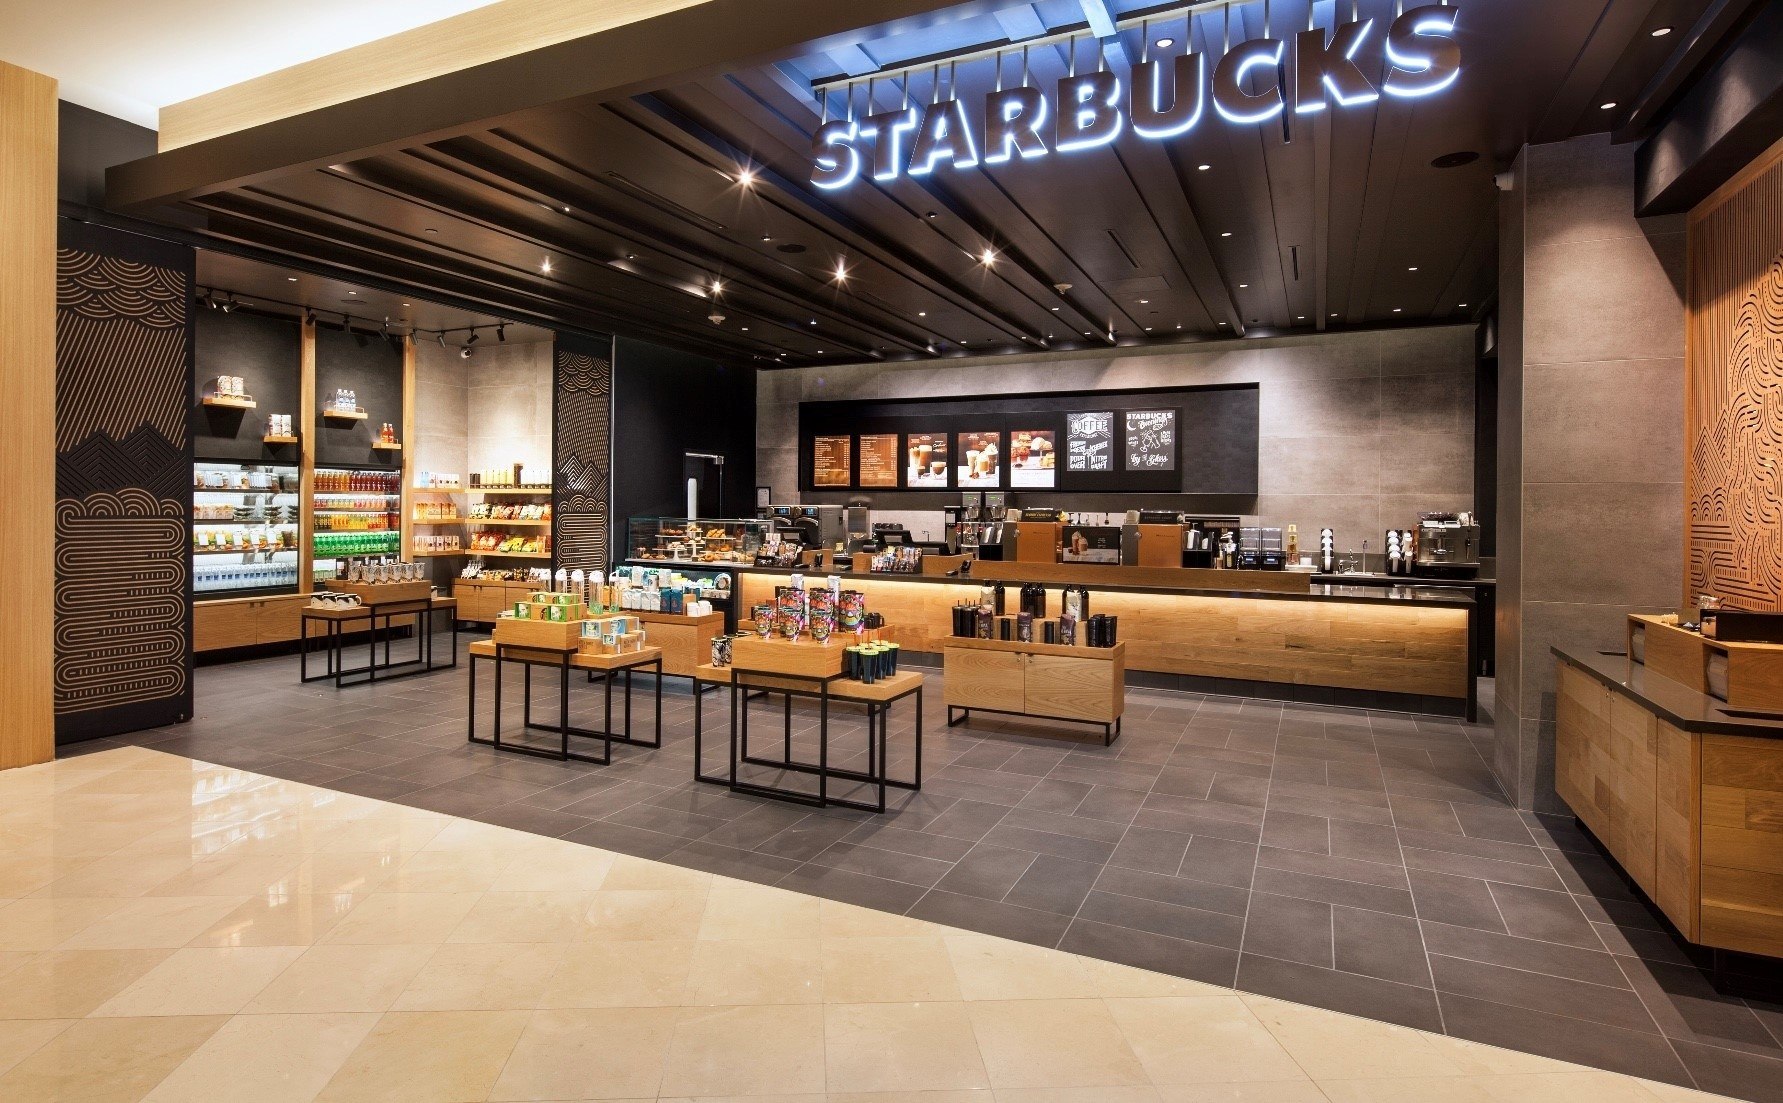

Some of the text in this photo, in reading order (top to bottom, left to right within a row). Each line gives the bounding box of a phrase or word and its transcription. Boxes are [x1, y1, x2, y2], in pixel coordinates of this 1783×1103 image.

[809, 5, 1462, 190] STARBUCKS
[1126, 412, 1173, 420] STARBUCKS
[1071, 419, 1108, 434] COFFEE
